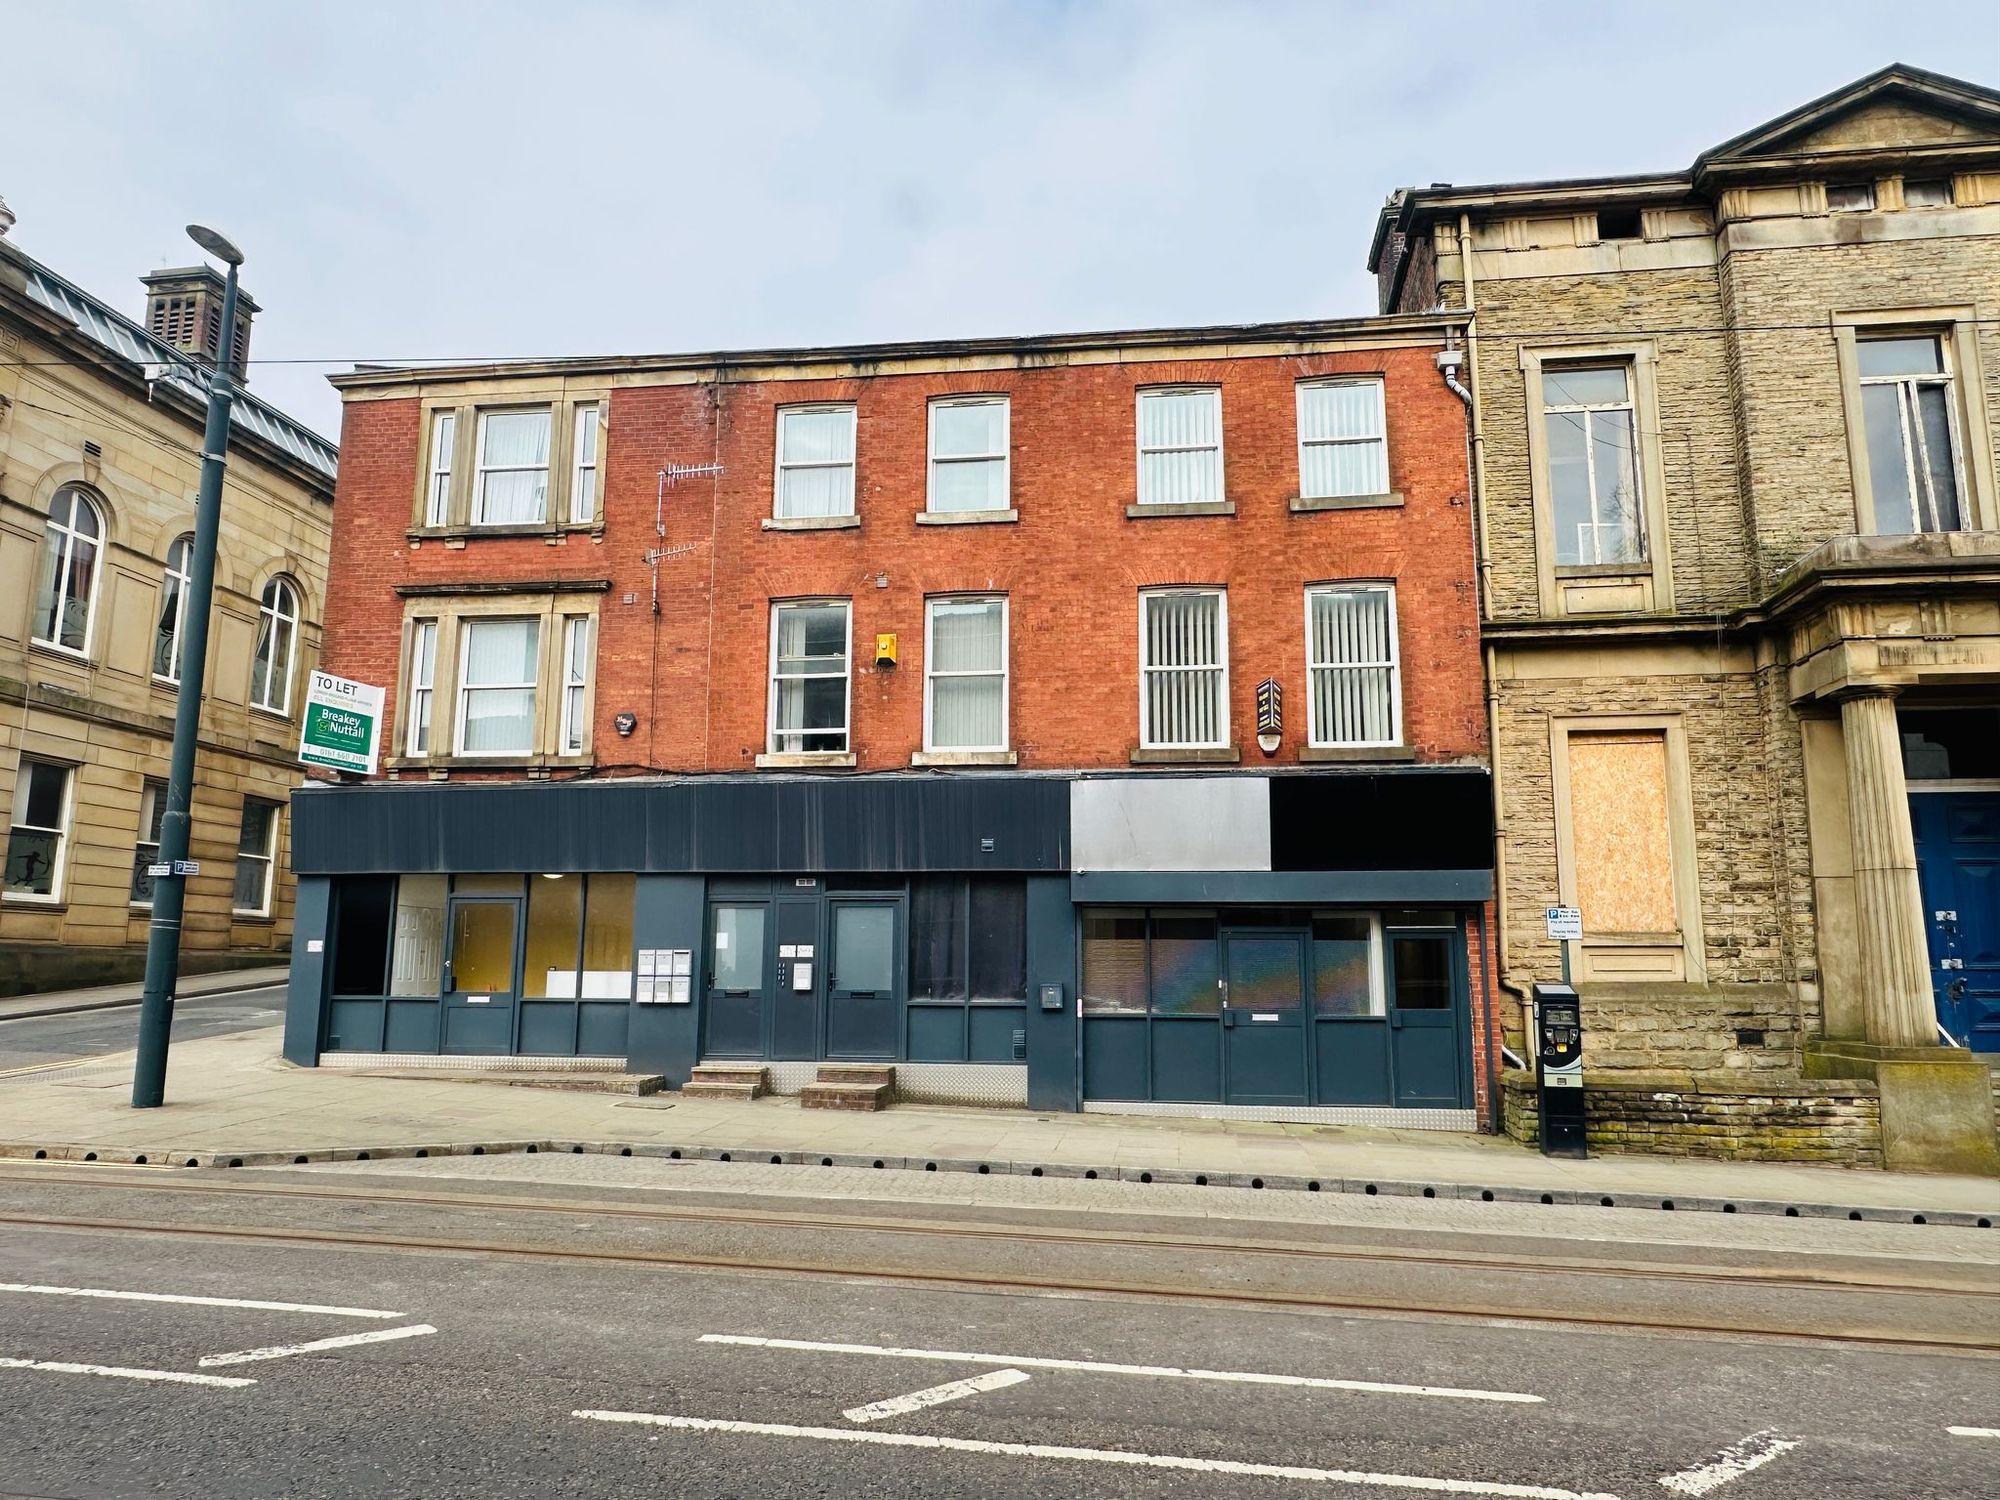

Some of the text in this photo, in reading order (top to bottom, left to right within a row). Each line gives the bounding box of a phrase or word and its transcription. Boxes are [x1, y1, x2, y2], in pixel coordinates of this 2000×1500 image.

[316, 676, 358, 696] TO LET
[322, 709, 360, 728] Breakey
[330, 722, 364, 738] Nuttall
[177, 863, 183, 871] P
[1550, 910, 1557, 918] P
